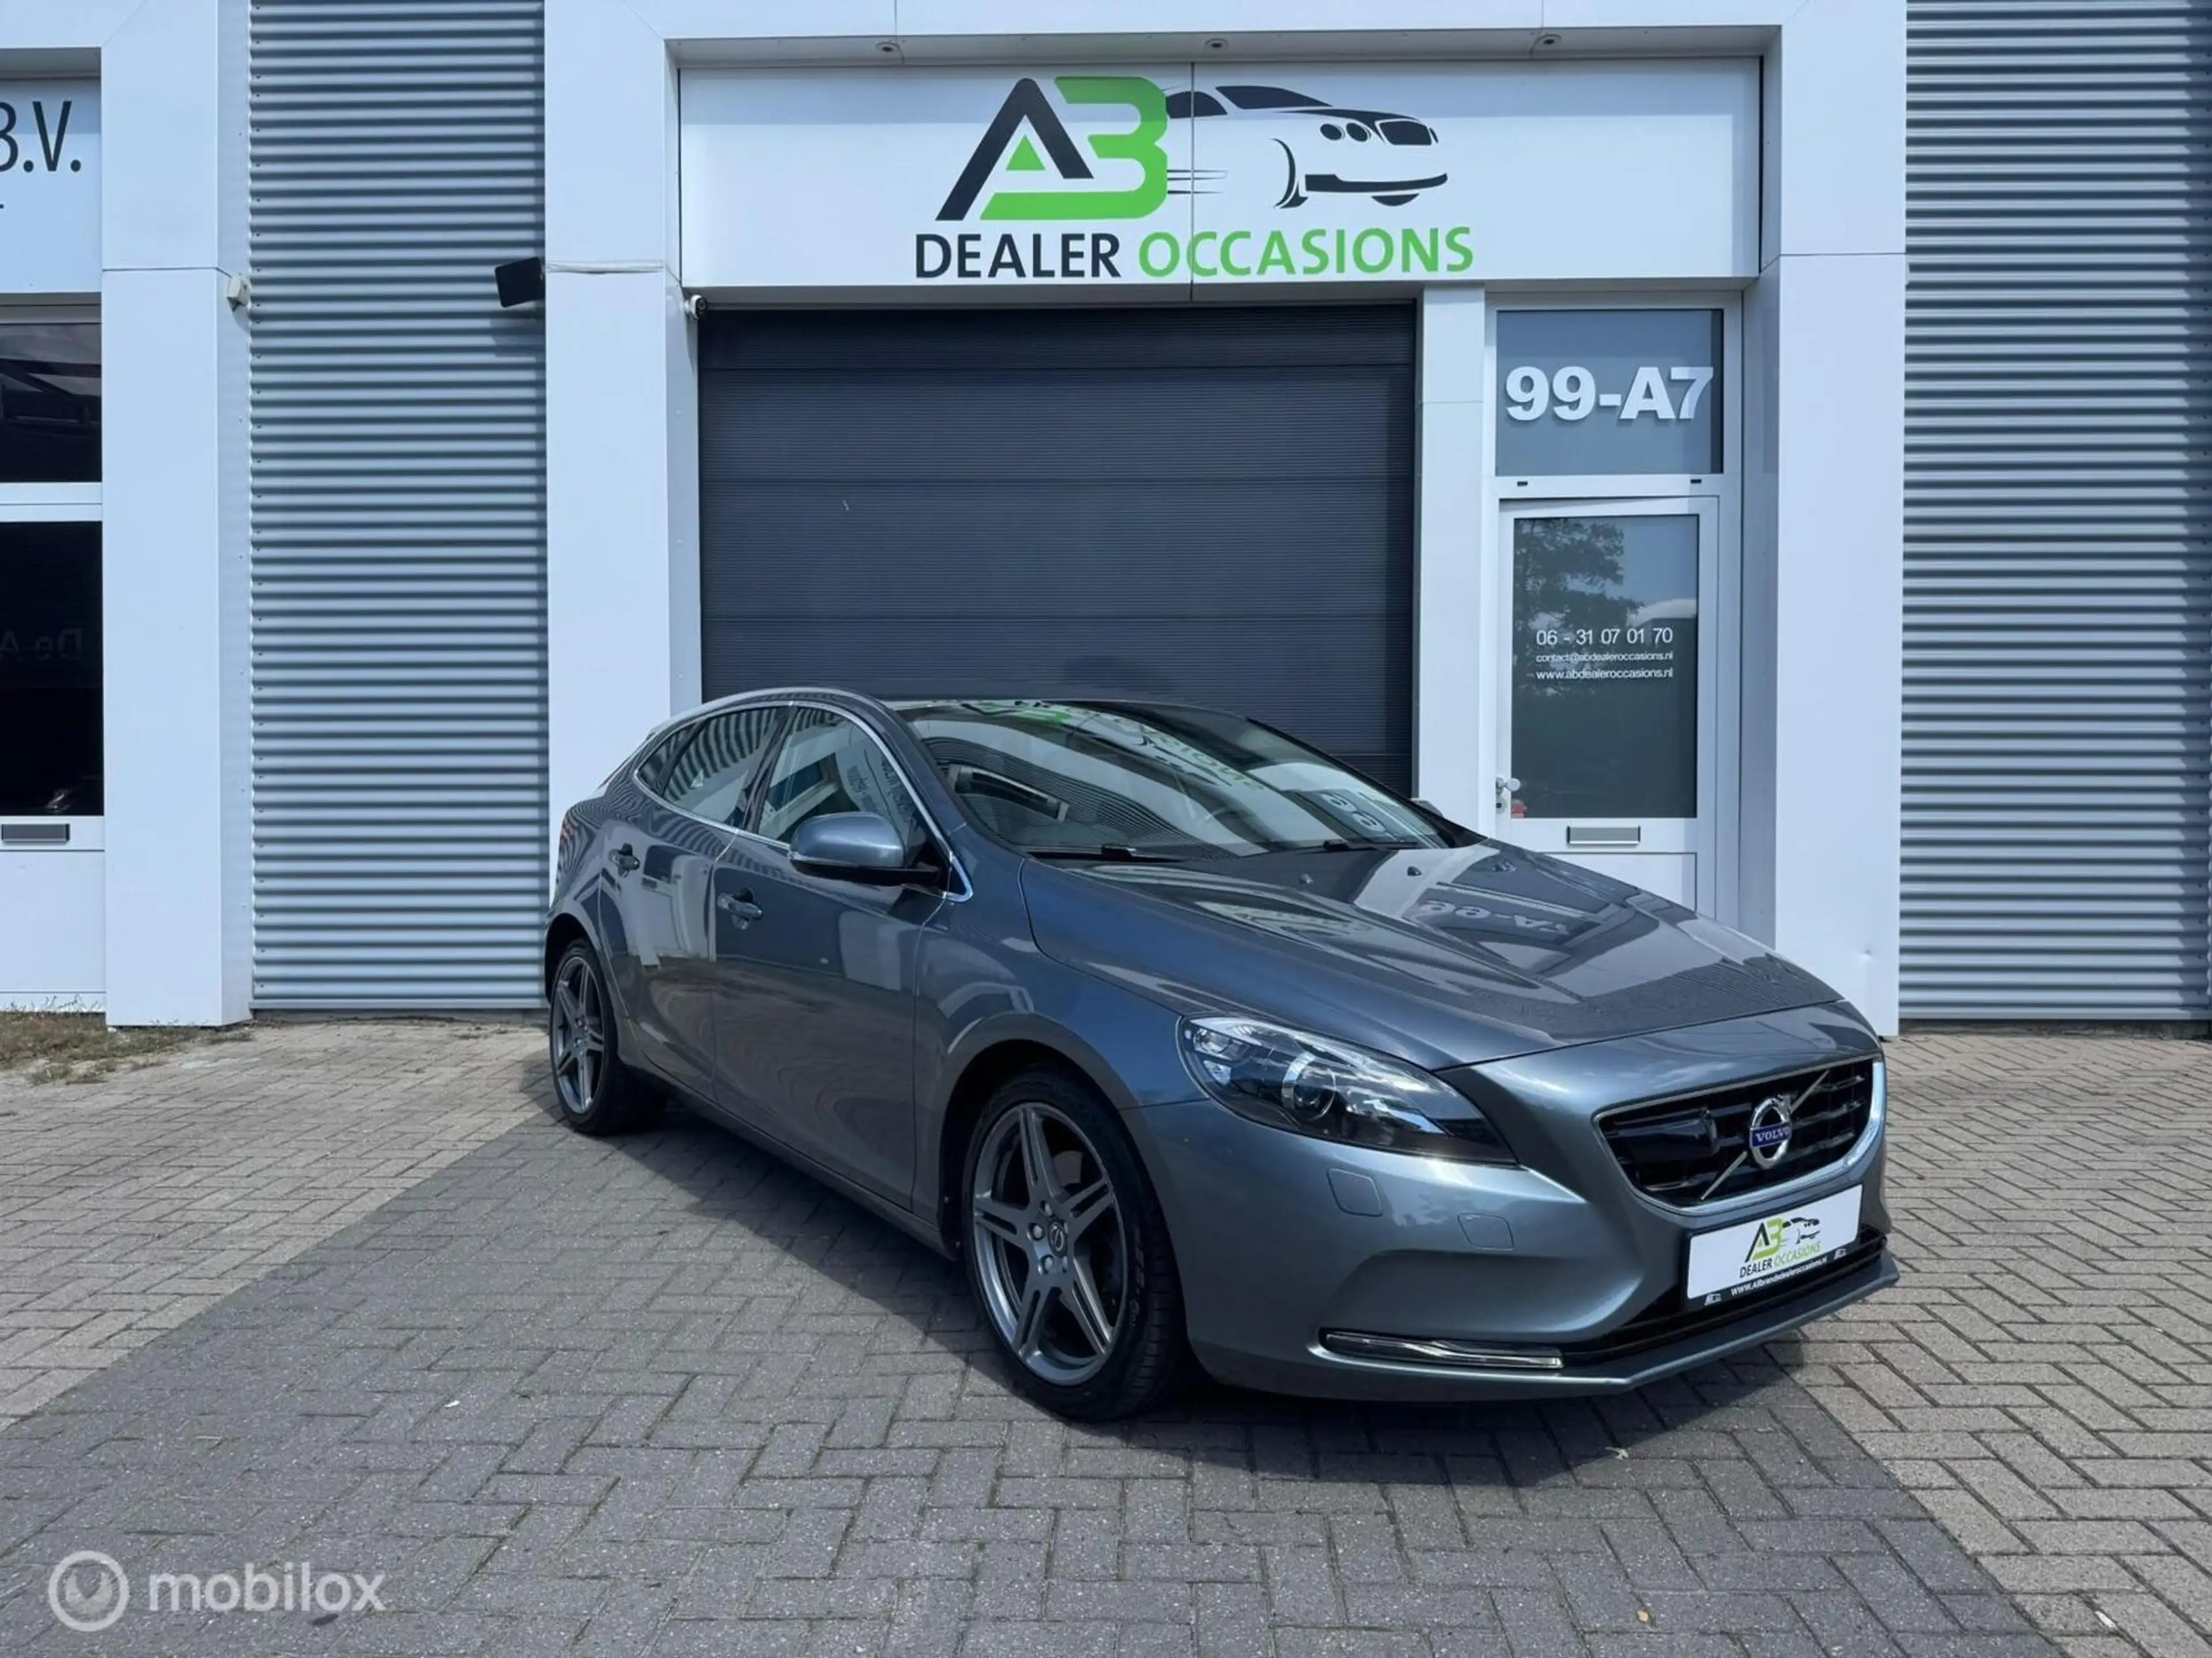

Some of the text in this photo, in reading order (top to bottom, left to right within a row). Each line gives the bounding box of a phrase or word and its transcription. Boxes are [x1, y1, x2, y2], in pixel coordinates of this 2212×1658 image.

[916, 227, 1474, 278] DEALER OCCASIONS
[1505, 366, 1714, 421] 99-A7
[1536, 630, 1558, 646] 06
[1575, 629, 1593, 644] 31
[1601, 628, 1620, 644] 07
[1627, 628, 1645, 644] 01
[1653, 628, 1673, 643] 70
[1536, 651, 1673, 663] contact@abdealeroccasions.nl
[1536, 667, 1673, 680] www.abdealeroccasions.nl
[1755, 1126, 1791, 1143] VOLVO
[1738, 1257, 1773, 1279] DEALER
[1774, 1241, 1821, 1268] OCCASIONS
